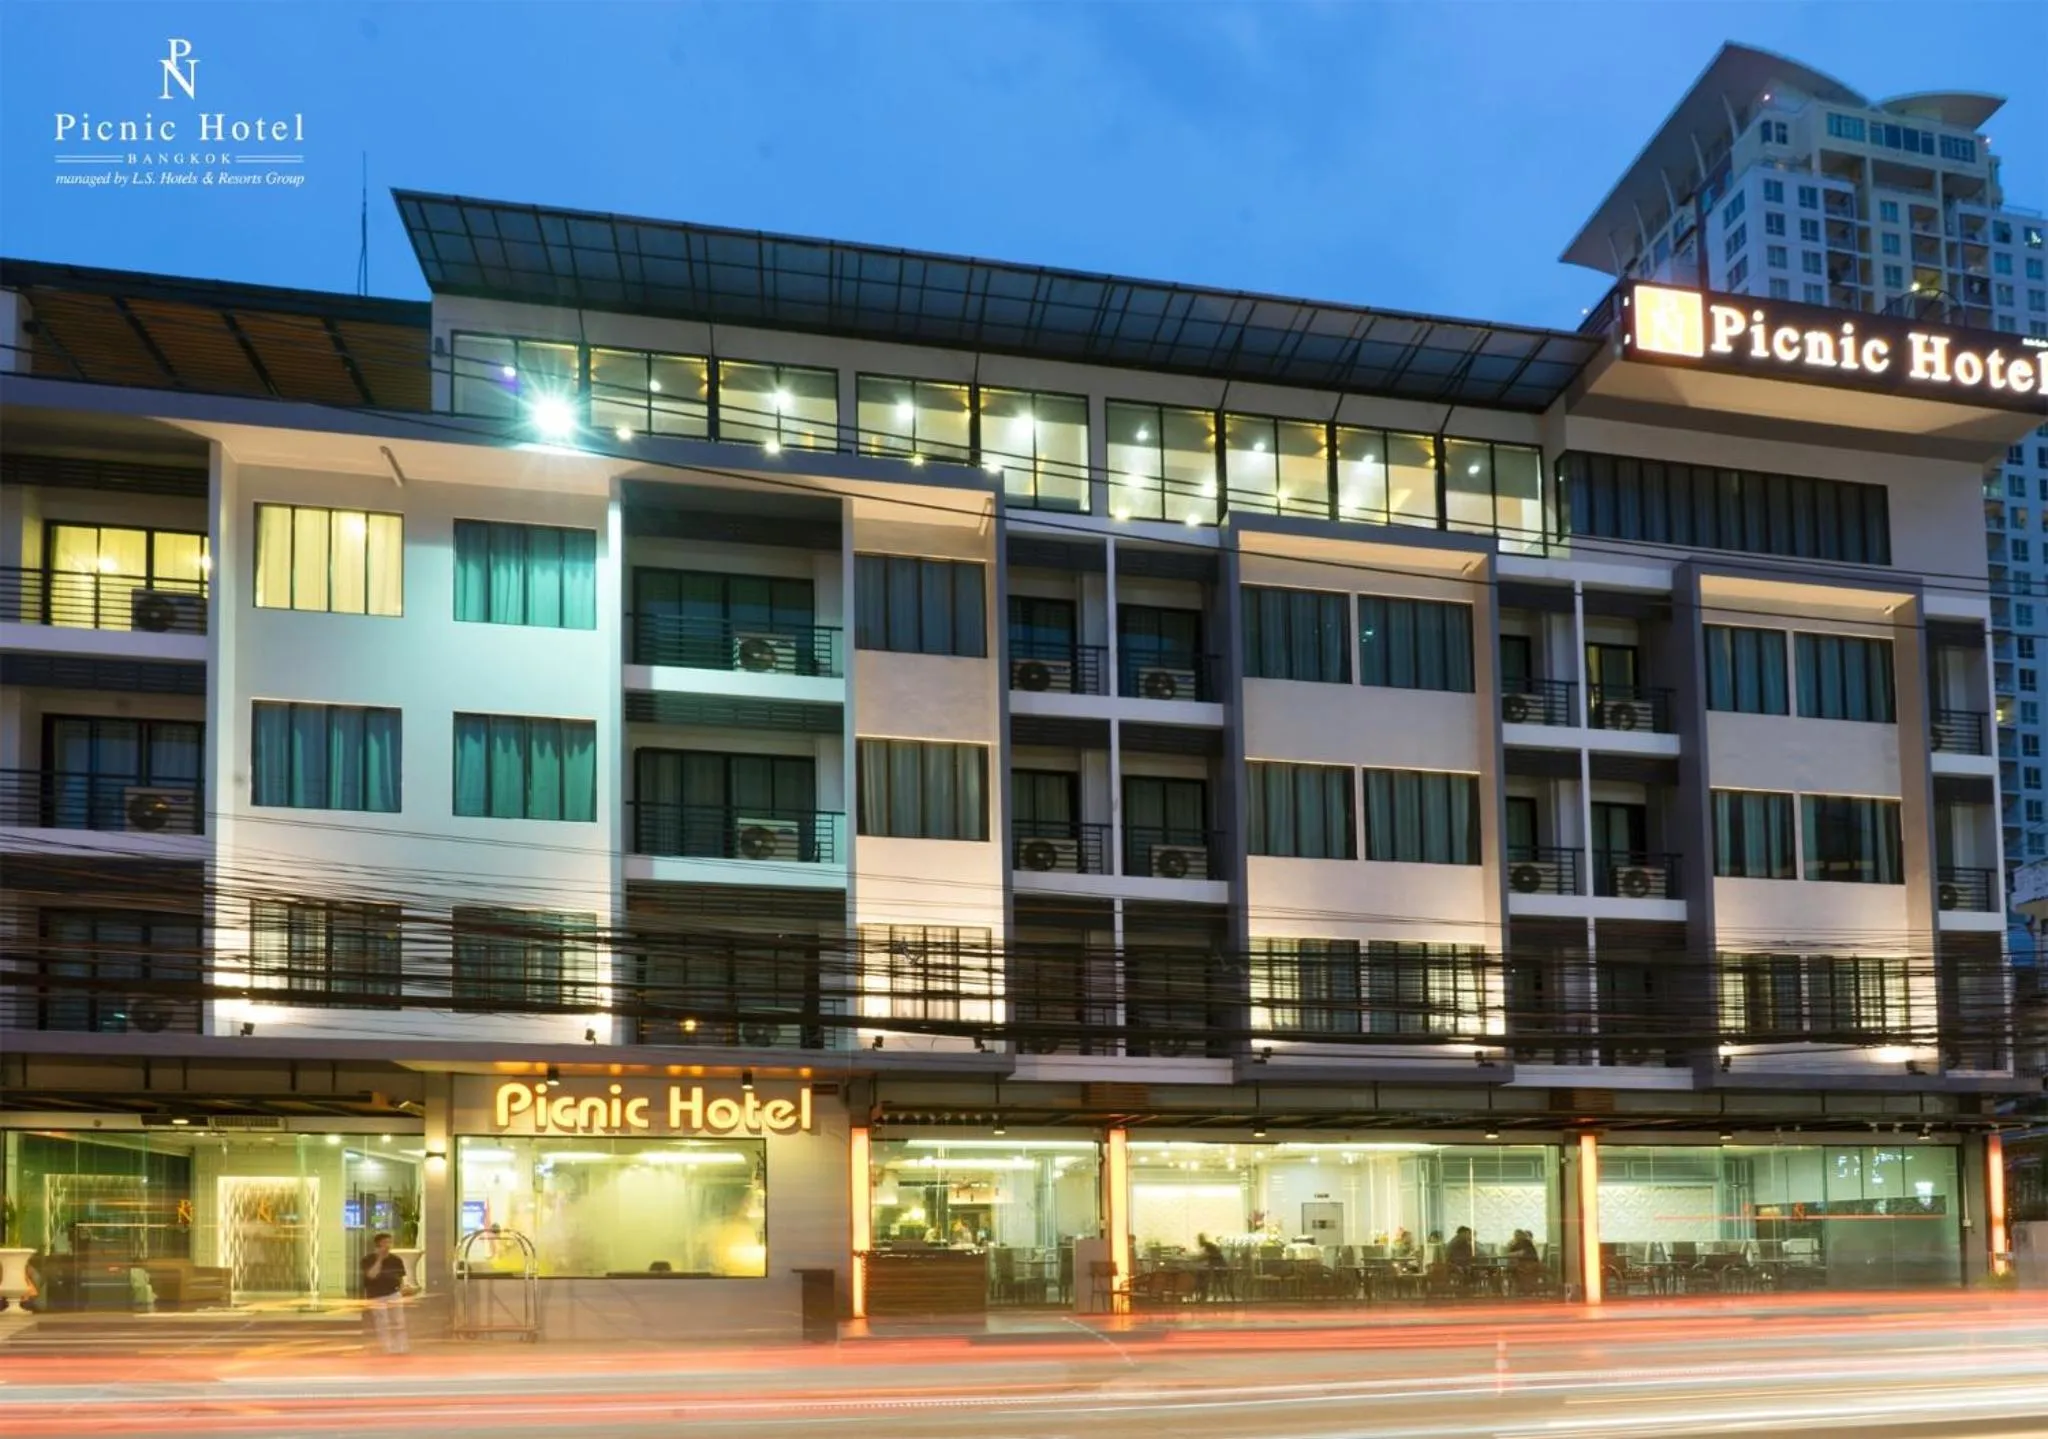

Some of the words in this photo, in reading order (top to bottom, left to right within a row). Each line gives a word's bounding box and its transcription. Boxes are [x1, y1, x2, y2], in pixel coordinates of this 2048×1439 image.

[1710, 303, 1891, 374] Picnic
[1907, 331, 2048, 395] Hotel
[496, 1082, 649, 1129] Picnic
[669, 1085, 812, 1131] Hotel
